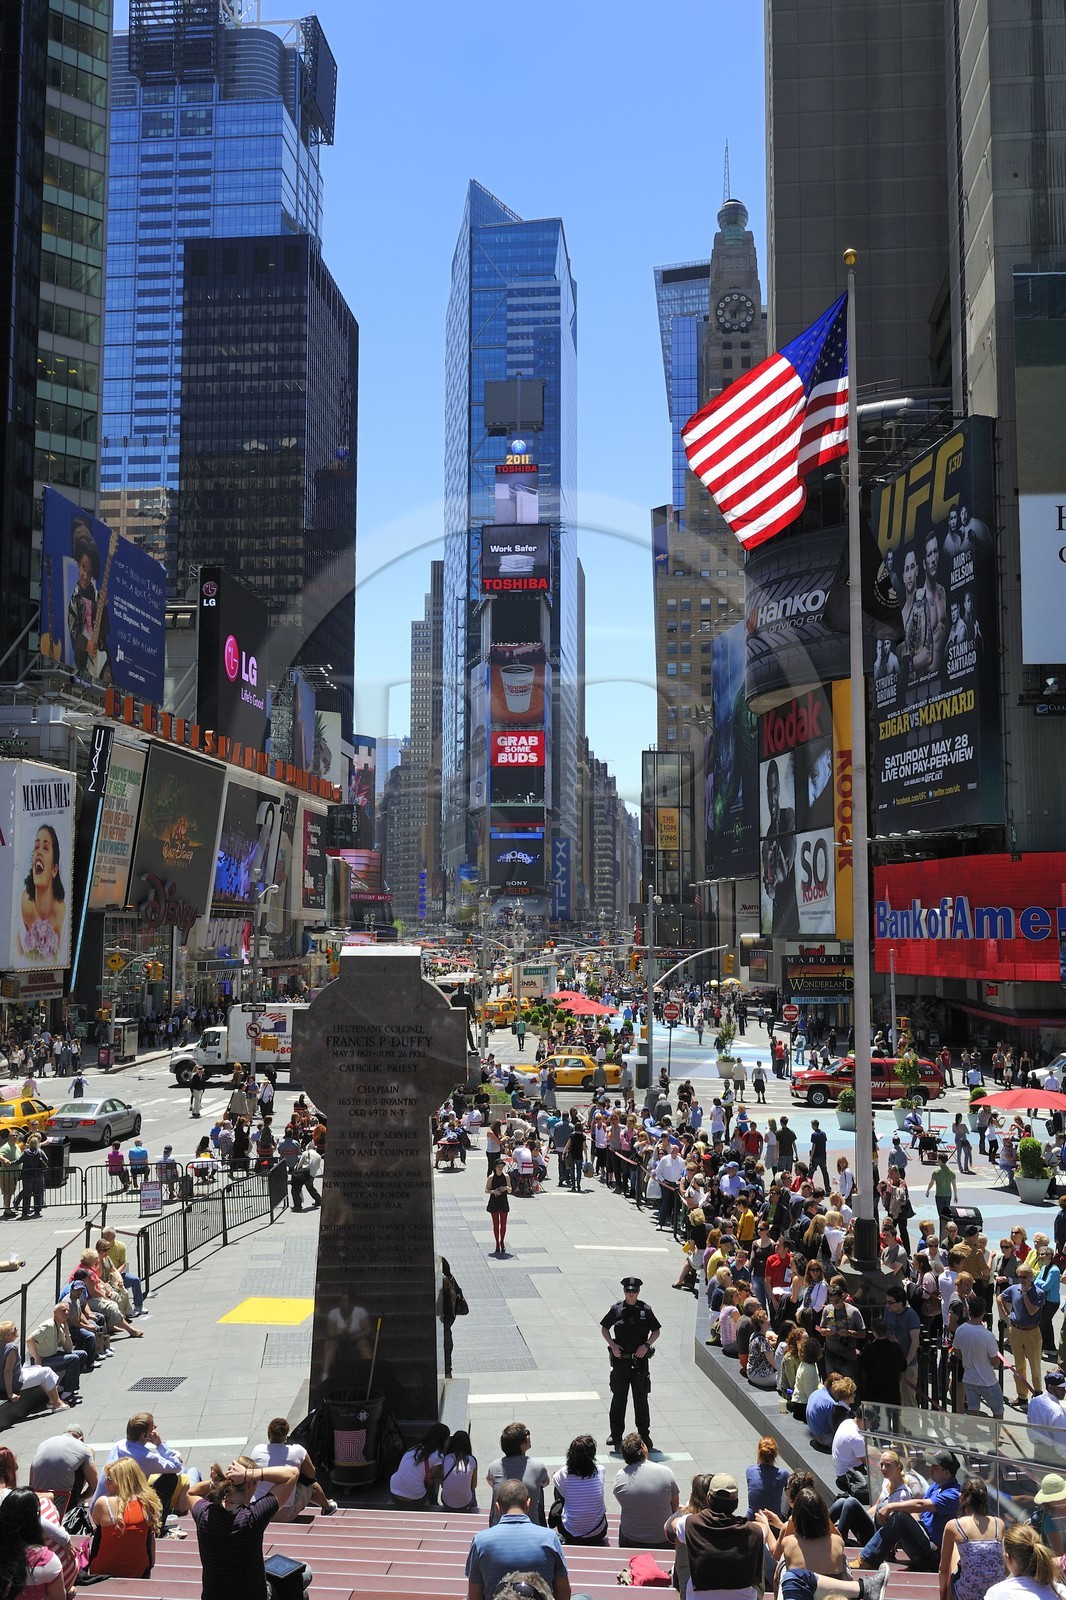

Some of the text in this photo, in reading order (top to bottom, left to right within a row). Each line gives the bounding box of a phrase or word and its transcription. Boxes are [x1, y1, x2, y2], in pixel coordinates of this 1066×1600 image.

[506, 455, 530, 465] 2011
[949, 455, 963, 475] 130
[878, 433, 965, 552] UFC
[515, 544, 537, 552] Safer
[950, 561, 975, 585] NELSON
[483, 578, 548, 589] TOSHIBA
[203, 599, 216, 607] LG
[769, 615, 803, 633] driving
[949, 640, 968, 660] STANN
[242, 651, 257, 687] LG
[947, 651, 977, 675] SANTIAGO
[242, 688, 264, 710] Life's Good
[928, 687, 964, 703] CHAMPIONSHIP
[763, 691, 823, 757] Kodak
[879, 713, 910, 740] EDGAR
[919, 689, 975, 727] MAYNARD
[497, 736, 539, 746] GRAB
[497, 753, 538, 763] BUDS
[885, 734, 969, 770] SATURDAY MAY 28
[881, 746, 974, 783] LIVE ON PAY-PER-VIEW
[22, 782, 70, 812] MAMMA MIA!
[801, 838, 829, 892] SO
[876, 899, 928, 939] Bank
[927, 896, 953, 939] of
[333, 1025, 424, 1033] LIEUTENANT COLONEL
[326, 1036, 433, 1047] FRANCIS DUFFY
[332, 1050, 348, 1058] MAY
[350, 1050, 354, 1058] 2
[398, 1050, 407, 1058] 26
[340, 1064, 418, 1072] CATHOLIC PRIEST
[358, 1085, 399, 1093] CHAPLAIN
